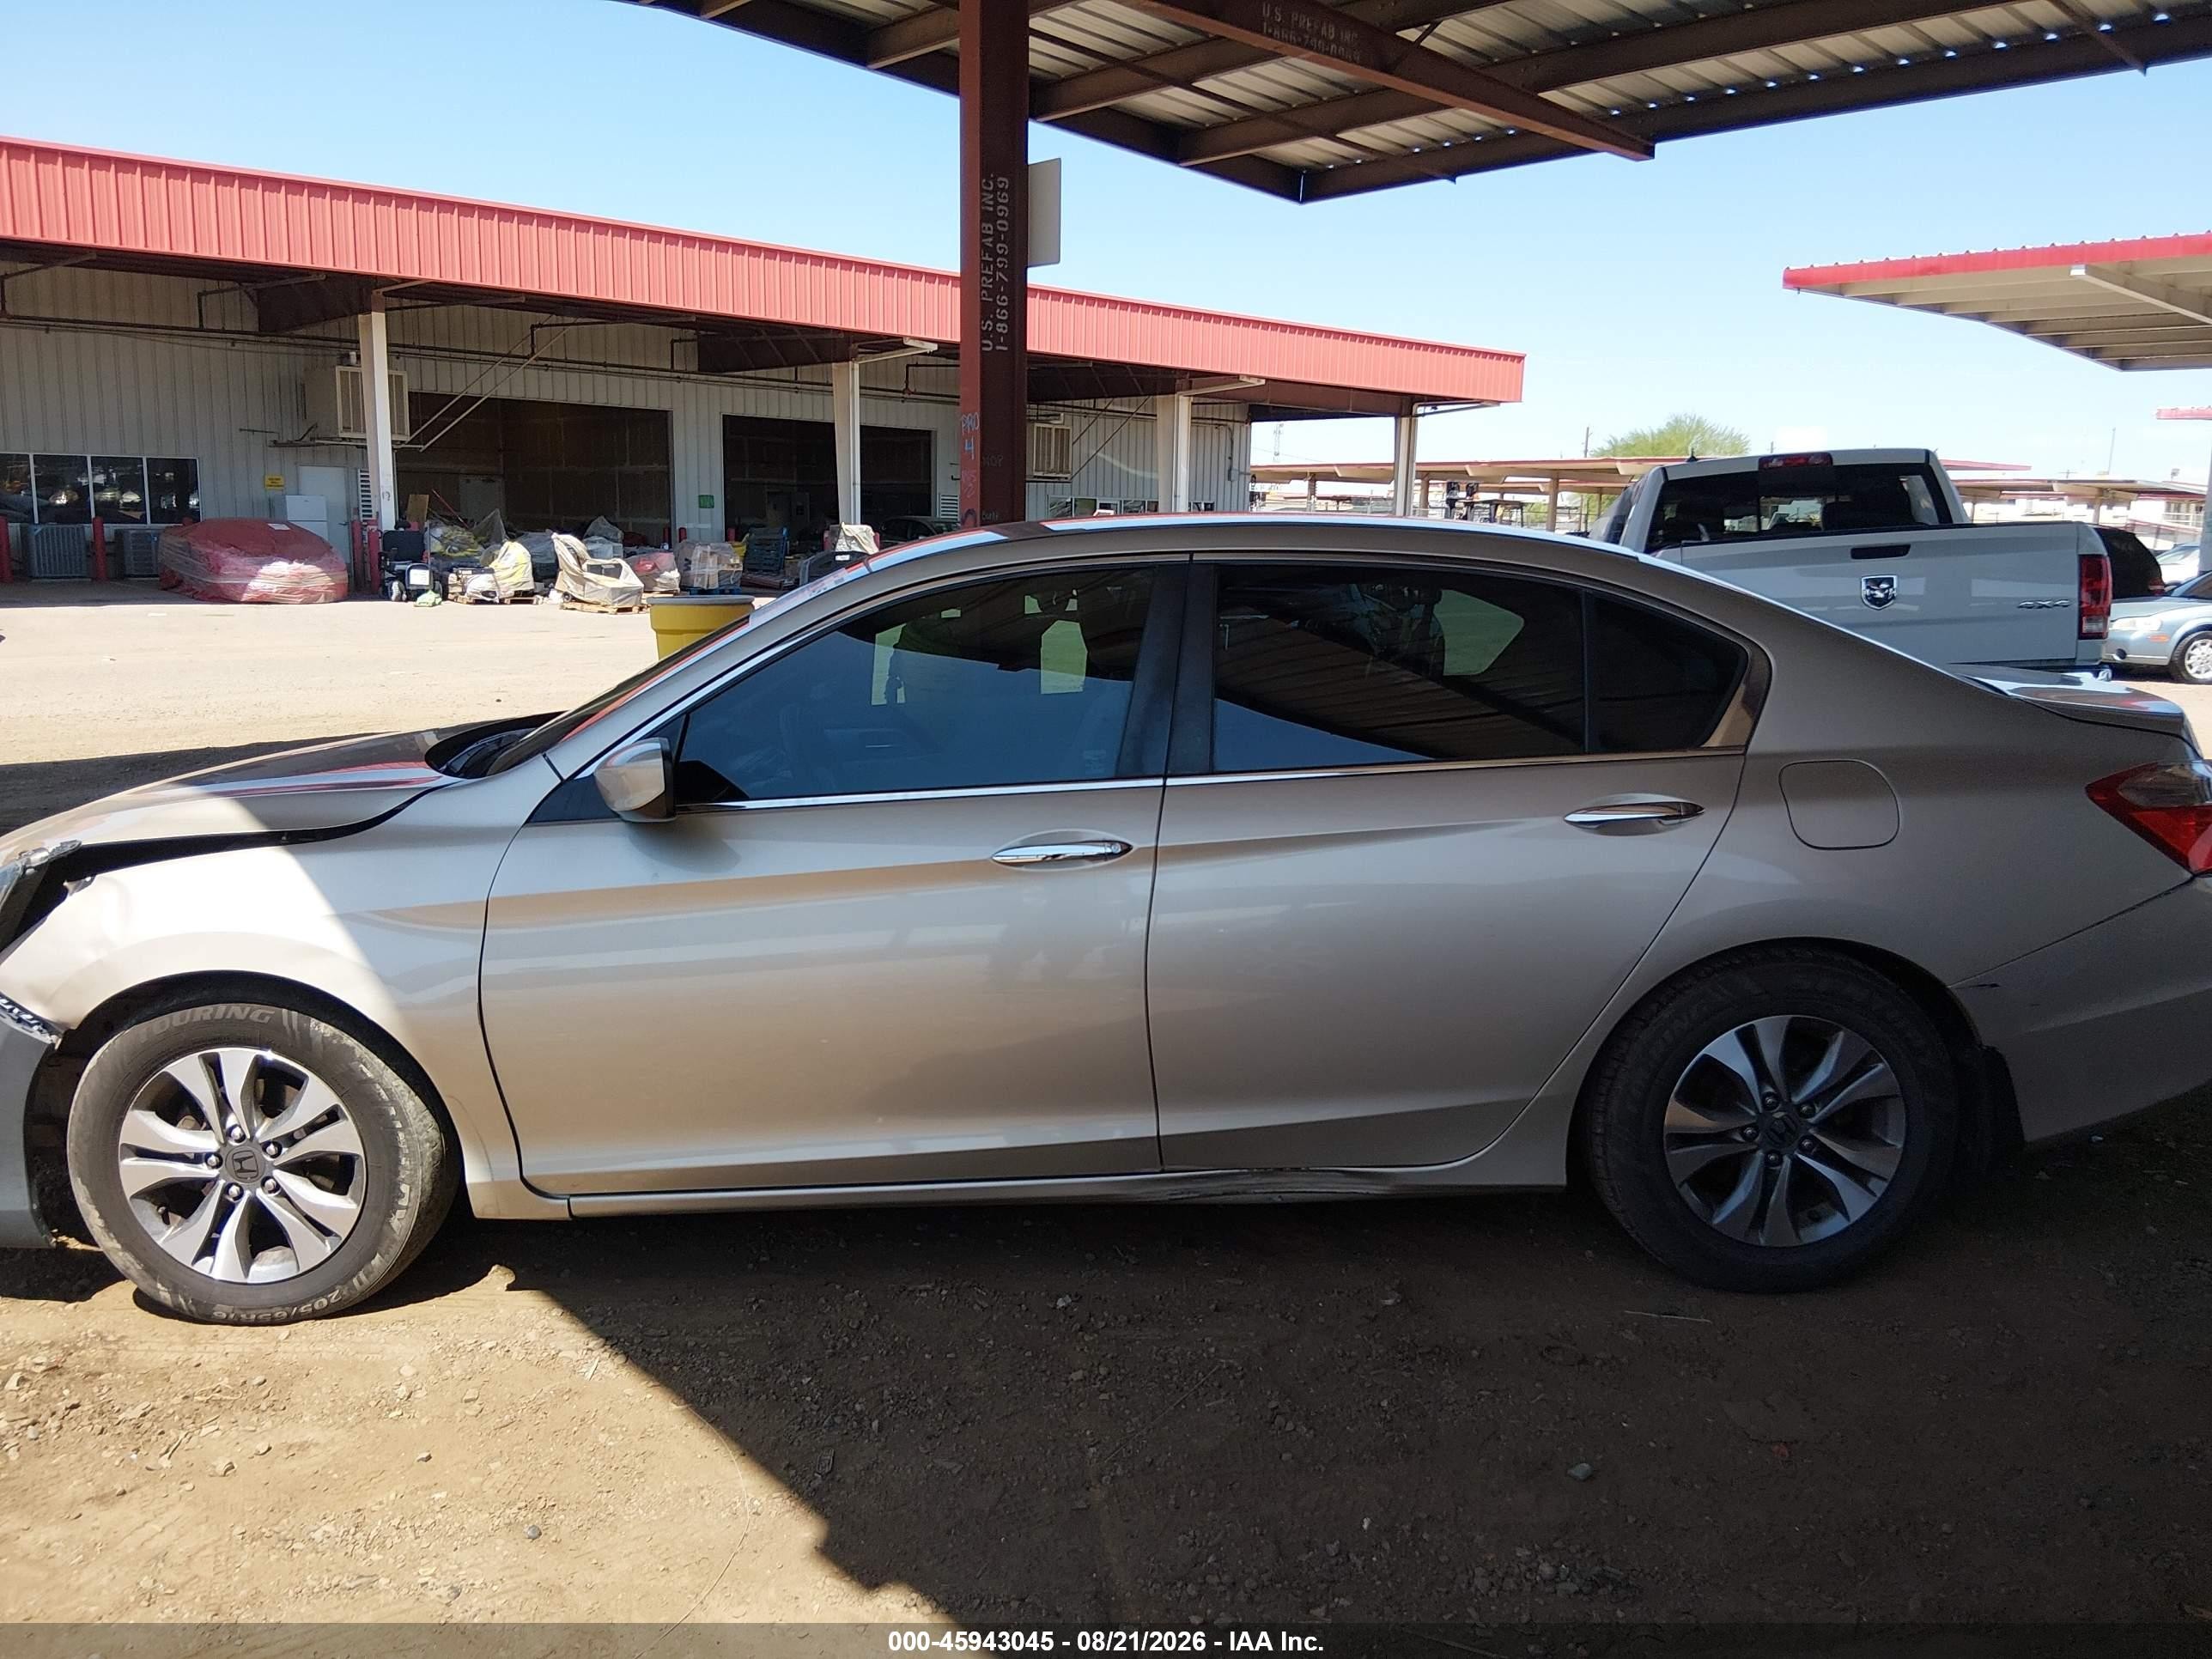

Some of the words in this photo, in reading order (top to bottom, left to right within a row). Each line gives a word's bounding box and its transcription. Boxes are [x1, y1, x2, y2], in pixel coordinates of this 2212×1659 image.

[981, 173, 994, 211] INC.
[981, 222, 994, 302] PREFAB
[995, 176, 1009, 351] 1-866-799-0969
[981, 313, 994, 352] U.S.
[137, 1005, 276, 1044] TOURING
